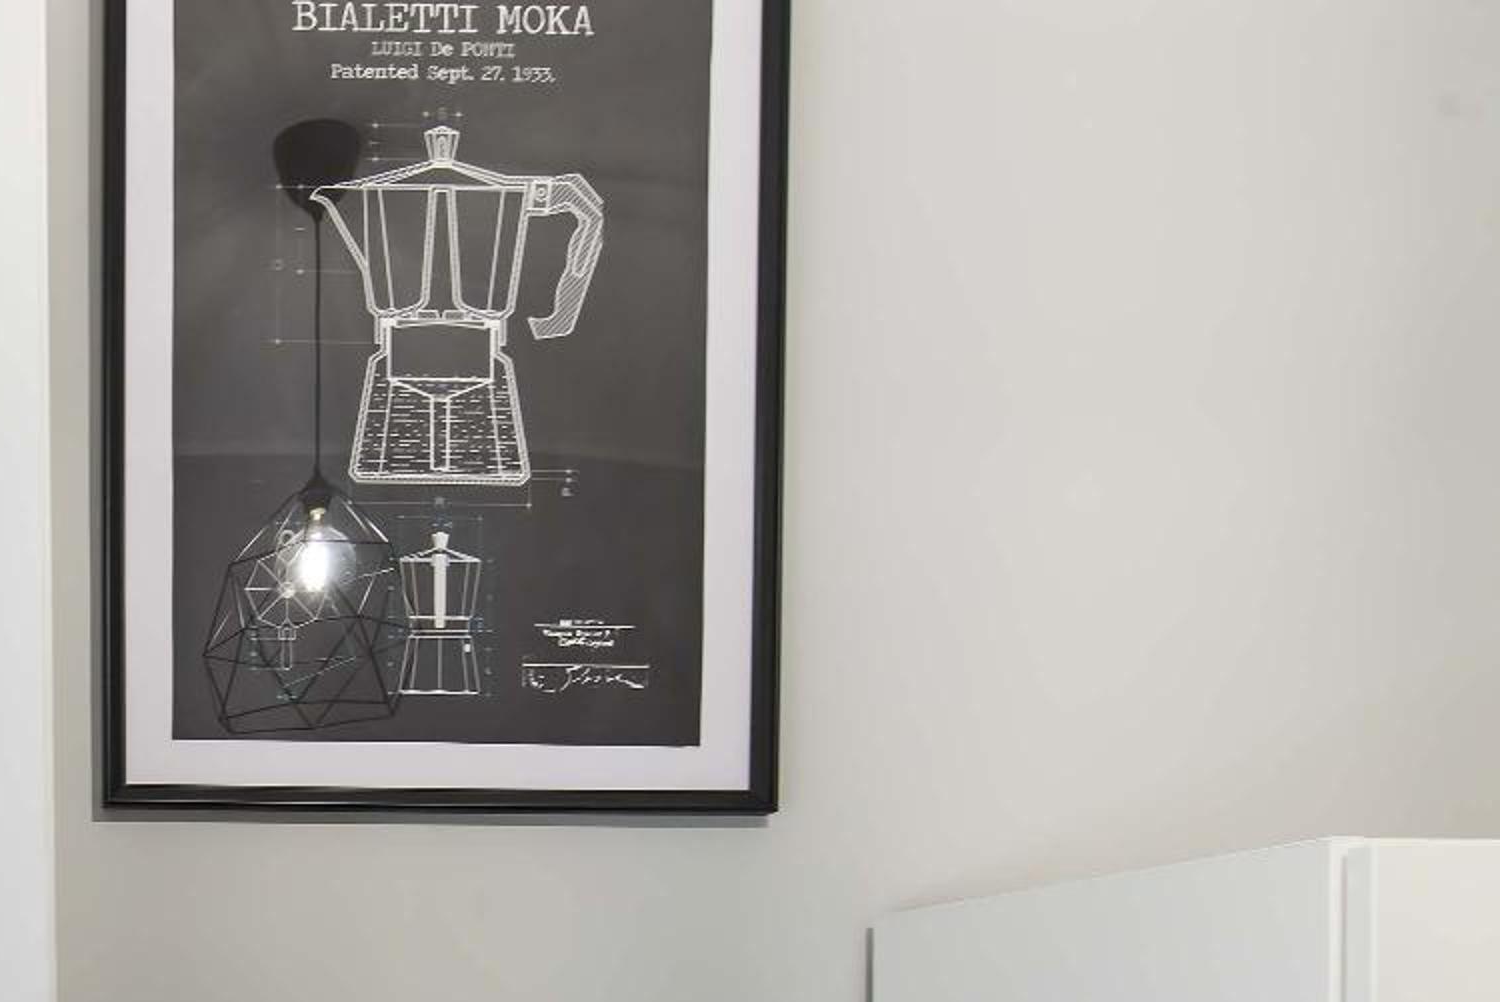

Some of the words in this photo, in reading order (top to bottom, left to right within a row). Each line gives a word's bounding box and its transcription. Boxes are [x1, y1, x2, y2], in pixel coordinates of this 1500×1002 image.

[291, 1, 479, 33] BIALETTI
[496, 5, 595, 36] MOKA
[372, 41, 423, 57] LUIGI
[430, 41, 453, 57] De
[330, 63, 419, 80] Patented
[426, 65, 475, 84] Sept.
